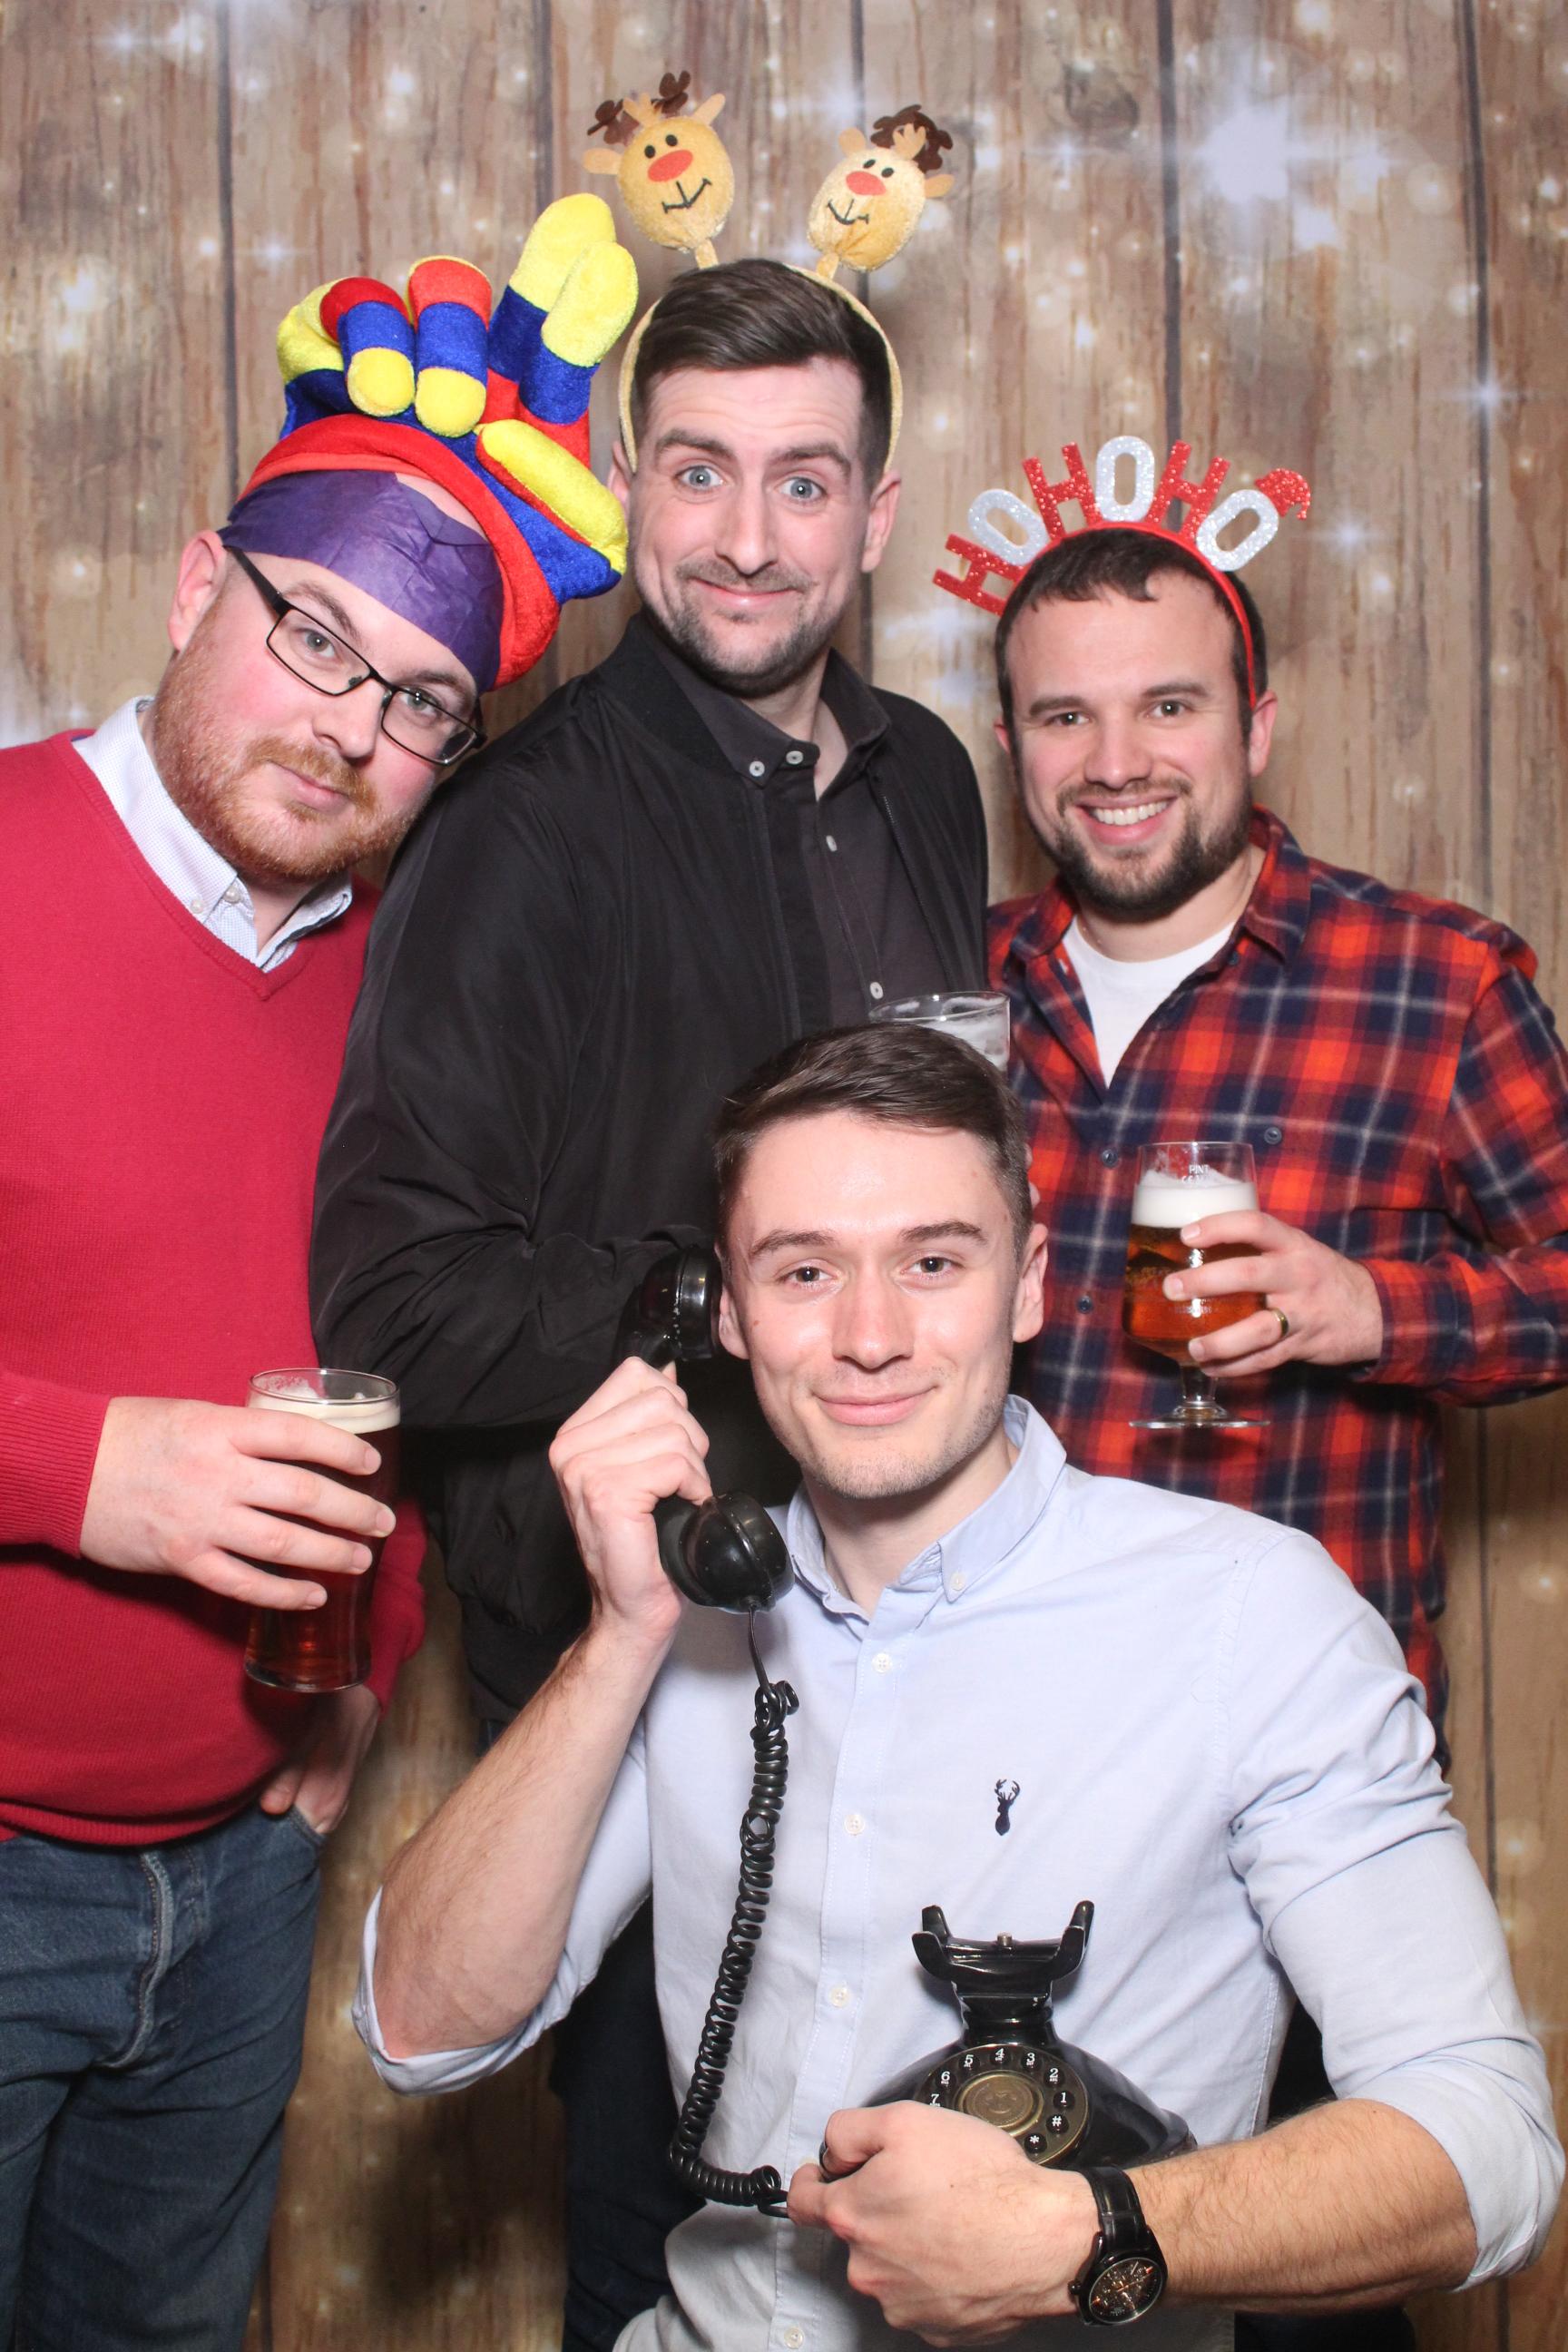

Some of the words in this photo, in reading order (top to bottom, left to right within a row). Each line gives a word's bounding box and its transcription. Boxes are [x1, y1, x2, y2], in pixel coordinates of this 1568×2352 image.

[995, 2048, 1004, 2059] 4
[1026, 2053, 1035, 2063] 3
[965, 2054, 974, 2064] 5
[941, 2071, 950, 2081] 6
[1049, 2068, 1059, 2078] 2
[931, 2093, 939, 2104] 7
[1061, 2092, 1067, 2103] 1
